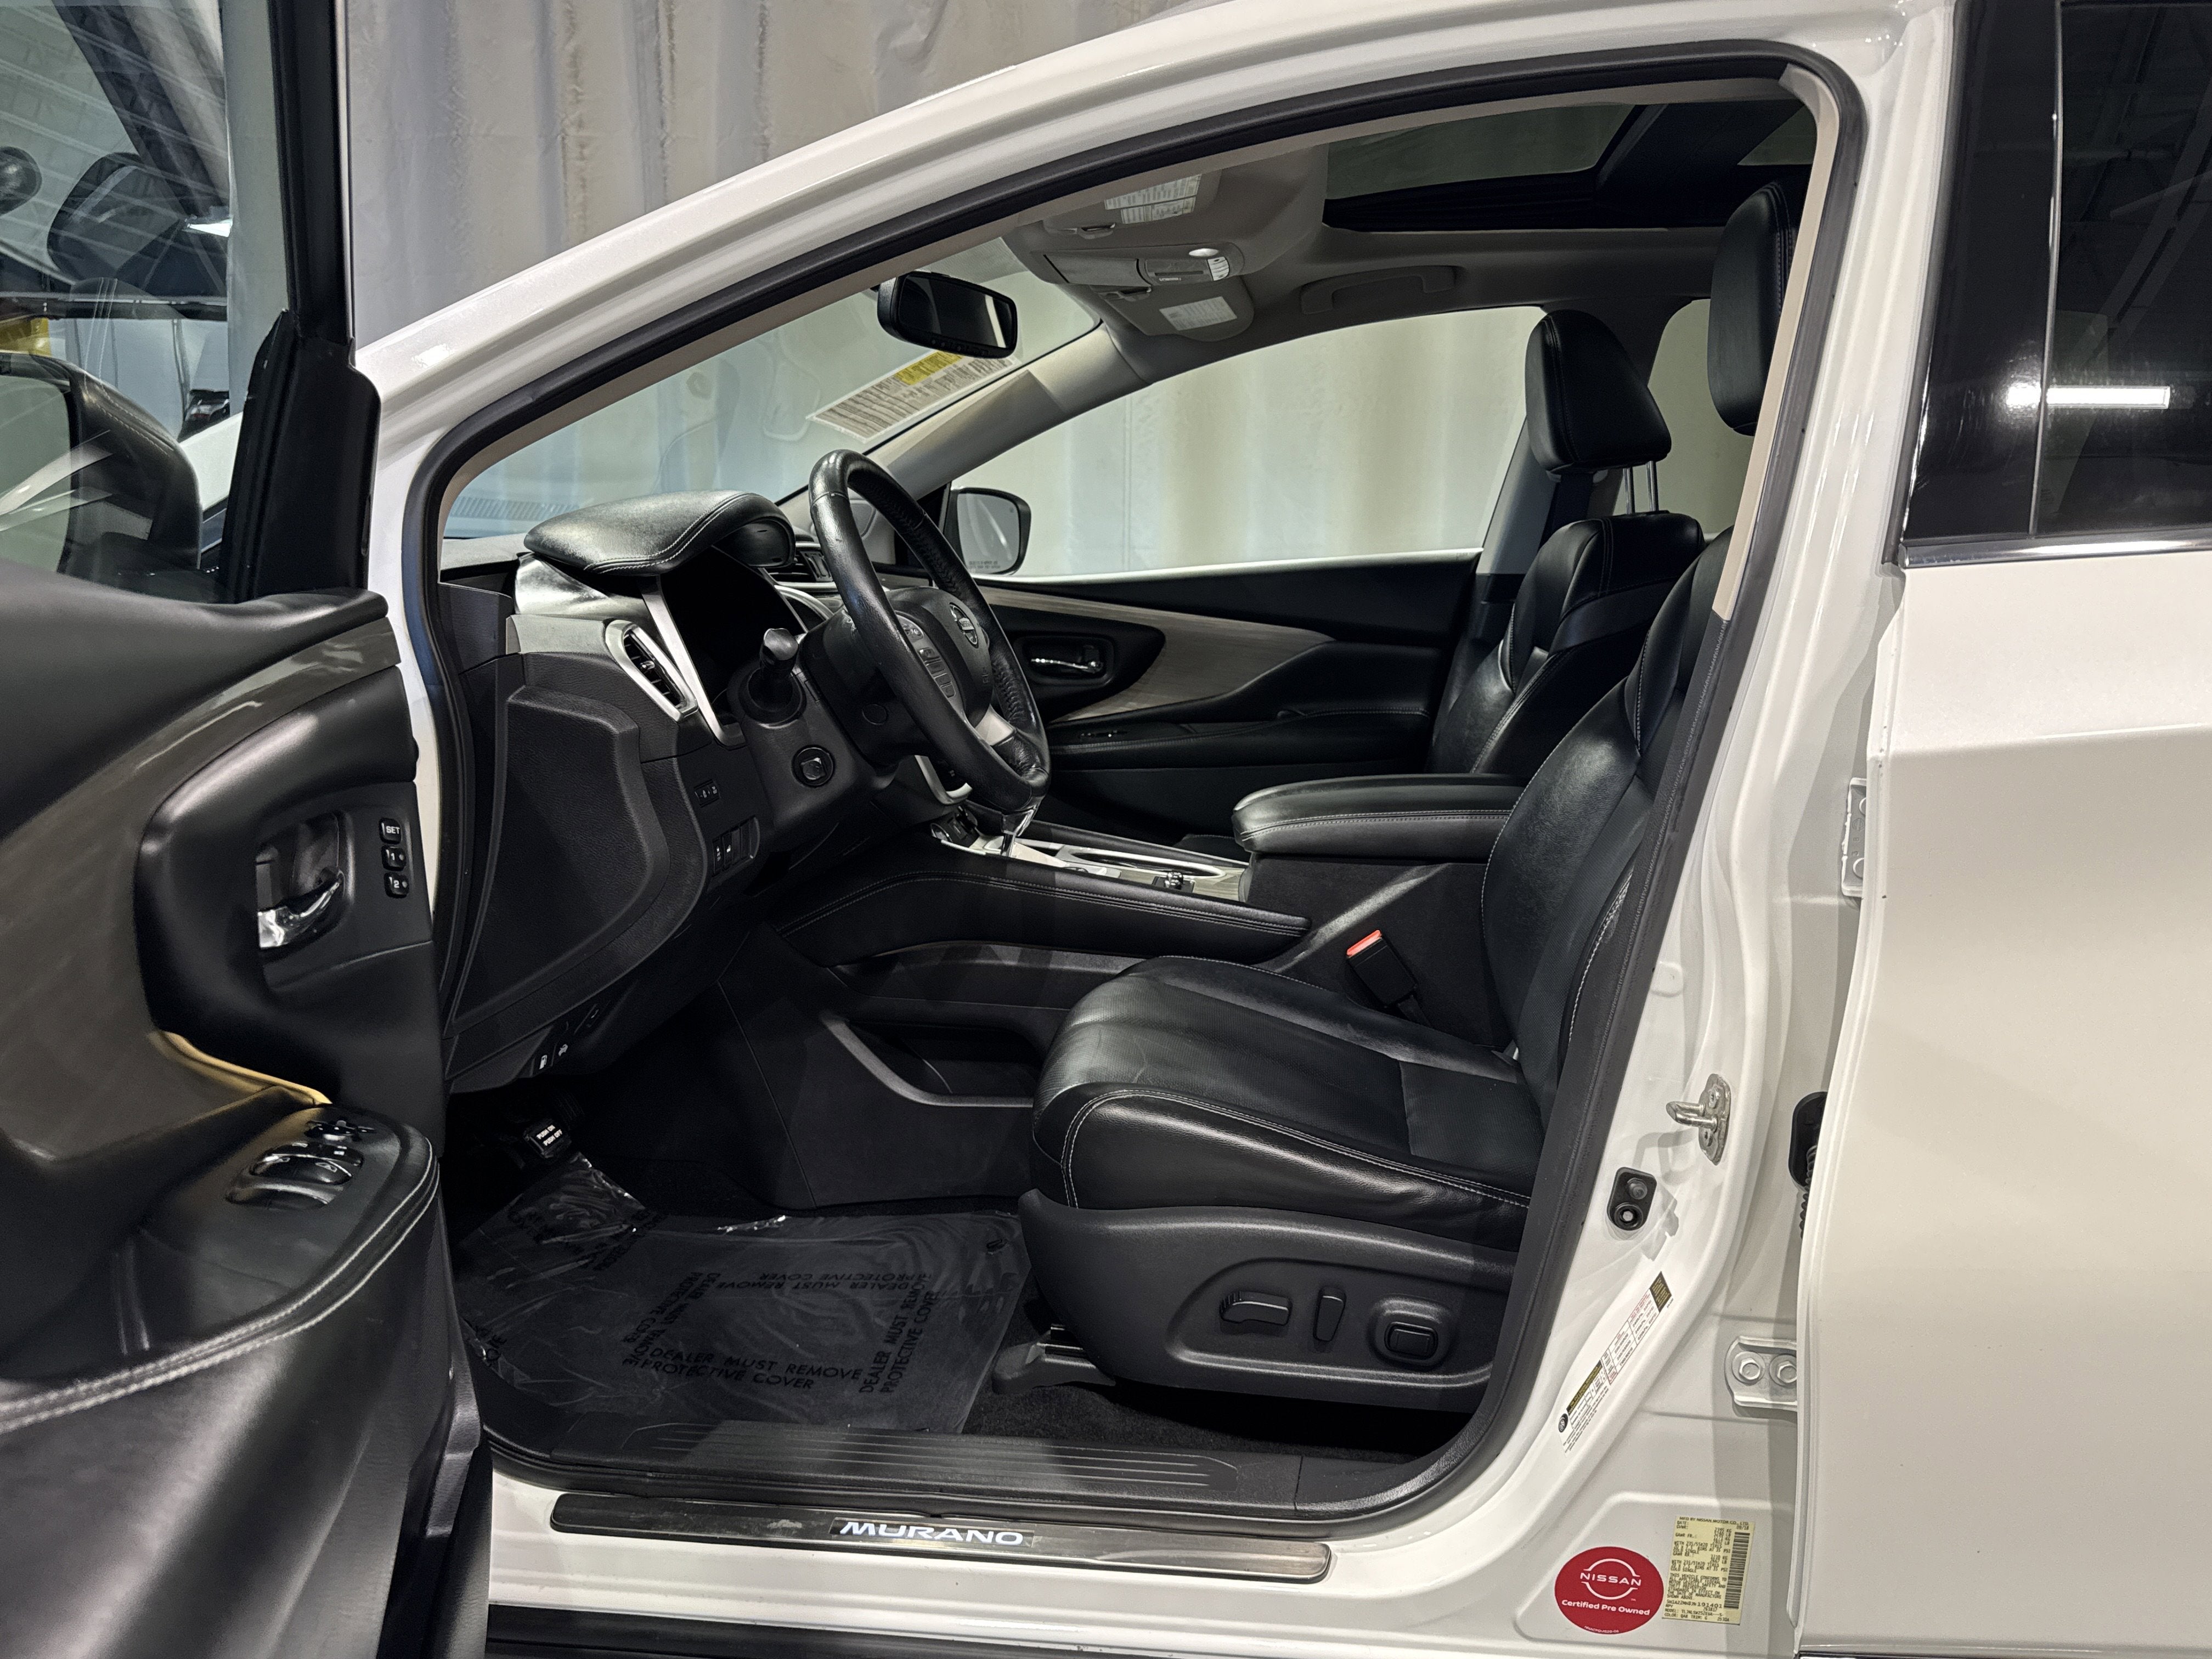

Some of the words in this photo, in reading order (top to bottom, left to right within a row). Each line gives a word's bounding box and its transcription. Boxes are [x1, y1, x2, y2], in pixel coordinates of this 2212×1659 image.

[386, 825, 400, 834] SET
[391, 853, 396, 861] 1
[393, 880, 399, 888] 2
[759, 1273, 813, 1281] COVER
[819, 1273, 915, 1282] PROTECTIVE
[714, 1281, 786, 1290] REMOVE
[792, 1282, 840, 1290] MUST
[858, 1350, 892, 1393] DEALER
[883, 1314, 909, 1345] MUST
[650, 1347, 714, 1363] DEALER
[723, 1356, 778, 1371] MUST
[785, 1363, 864, 1380] REMOVE
[878, 1328, 923, 1393] PROTECTIVE
[640, 1358, 748, 1381] PROTECTIVE
[752, 1373, 815, 1389] COVER
[839, 1521, 1024, 1545] MURANO
[1580, 1572, 1642, 1586] NISSAN
[1561, 1599, 1600, 1610] Certified
[1618, 1606, 1651, 1615] Owned
